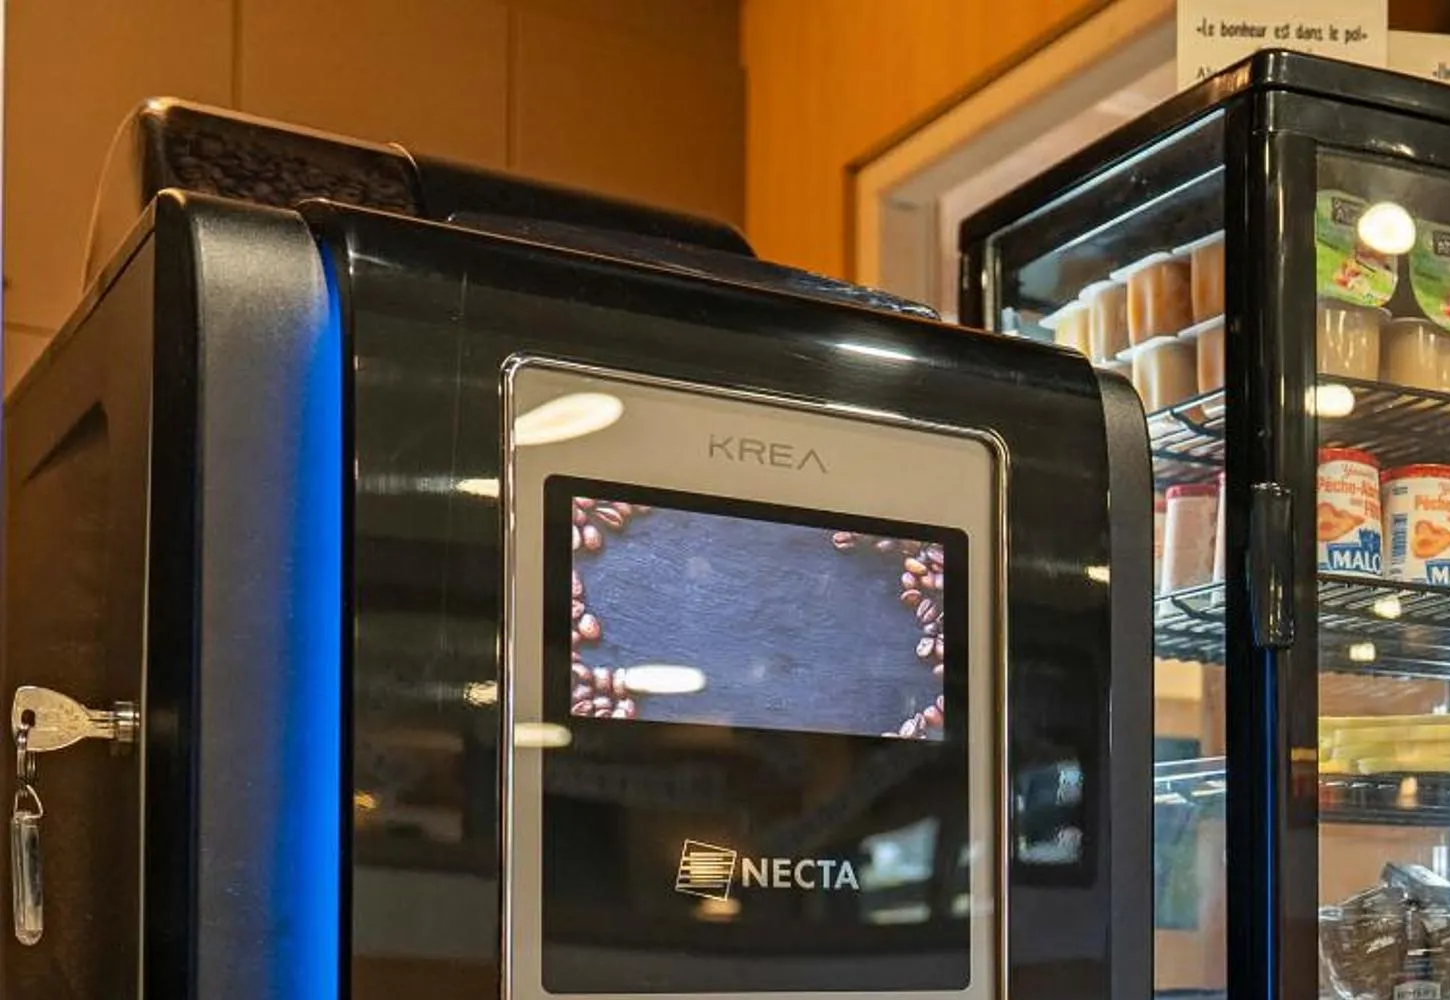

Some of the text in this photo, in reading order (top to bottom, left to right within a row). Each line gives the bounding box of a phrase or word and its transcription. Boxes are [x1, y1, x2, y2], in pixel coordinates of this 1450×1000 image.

[1220, 22, 1266, 38] bonheur
[709, 434, 828, 474] KREA
[741, 857, 860, 890] NECTA
